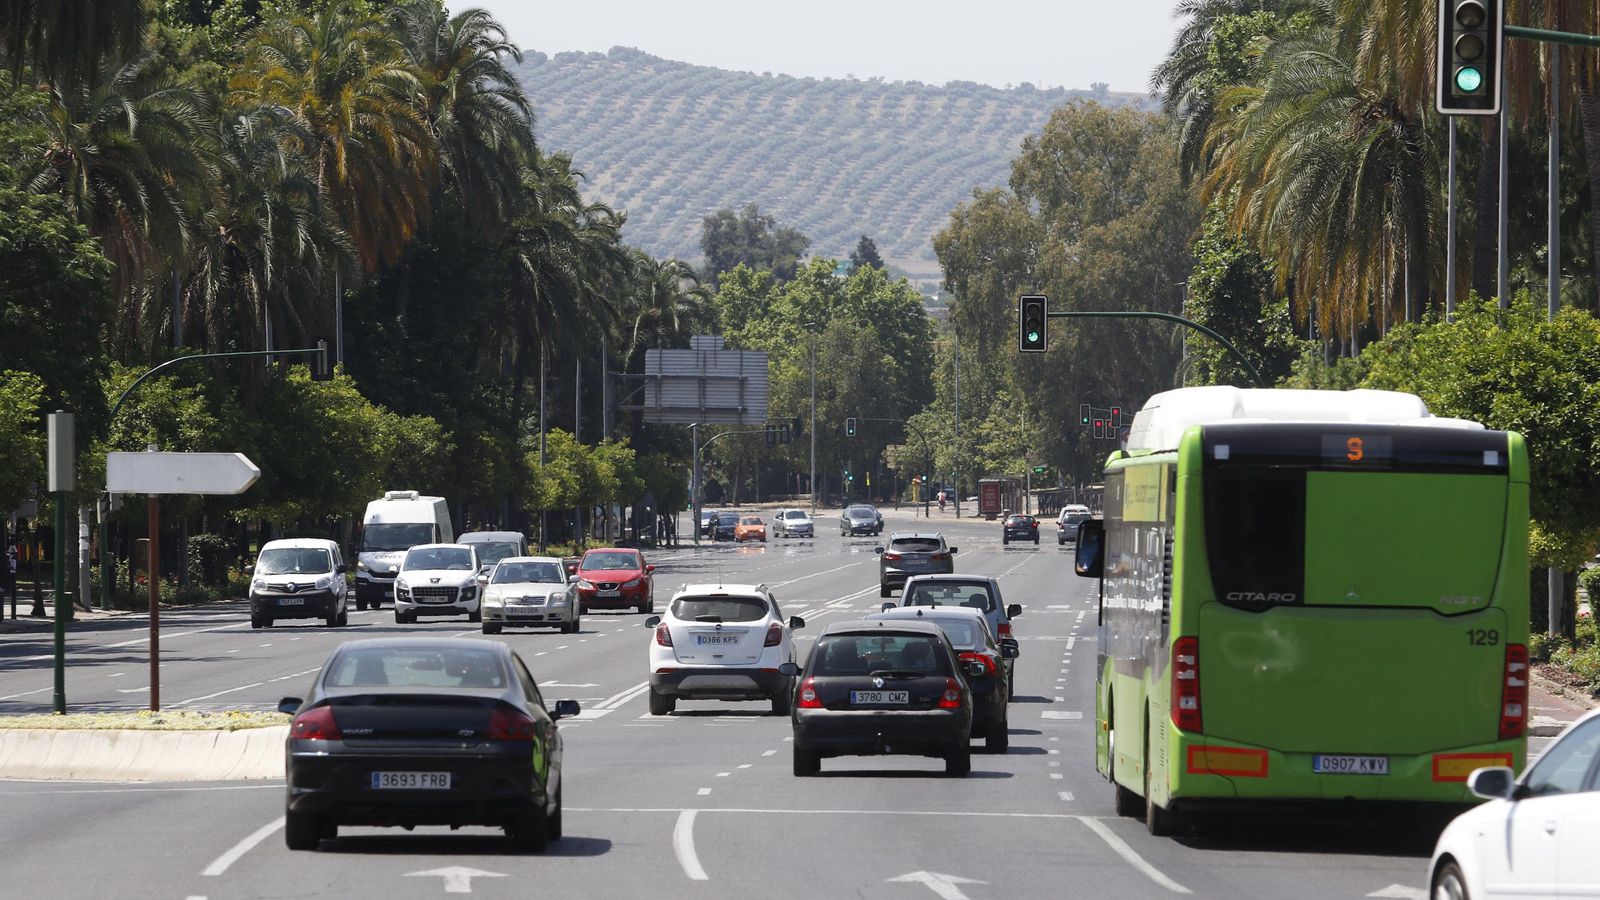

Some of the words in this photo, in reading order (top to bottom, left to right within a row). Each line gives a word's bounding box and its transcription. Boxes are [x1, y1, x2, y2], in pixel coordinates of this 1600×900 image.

[1346, 437, 1364, 461] S
[1226, 591, 1297, 602] CITARO
[1439, 595, 1481, 605] NGT
[722, 636, 738, 644] KPS
[1466, 629, 1499, 646] 129
[859, 692, 882, 703] 3780
[888, 692, 907, 703] CMZ
[1322, 757, 1355, 770] 0907
[1359, 757, 1385, 770] KWV
[382, 774, 417, 787] 3693
[420, 774, 447, 787] FRB
